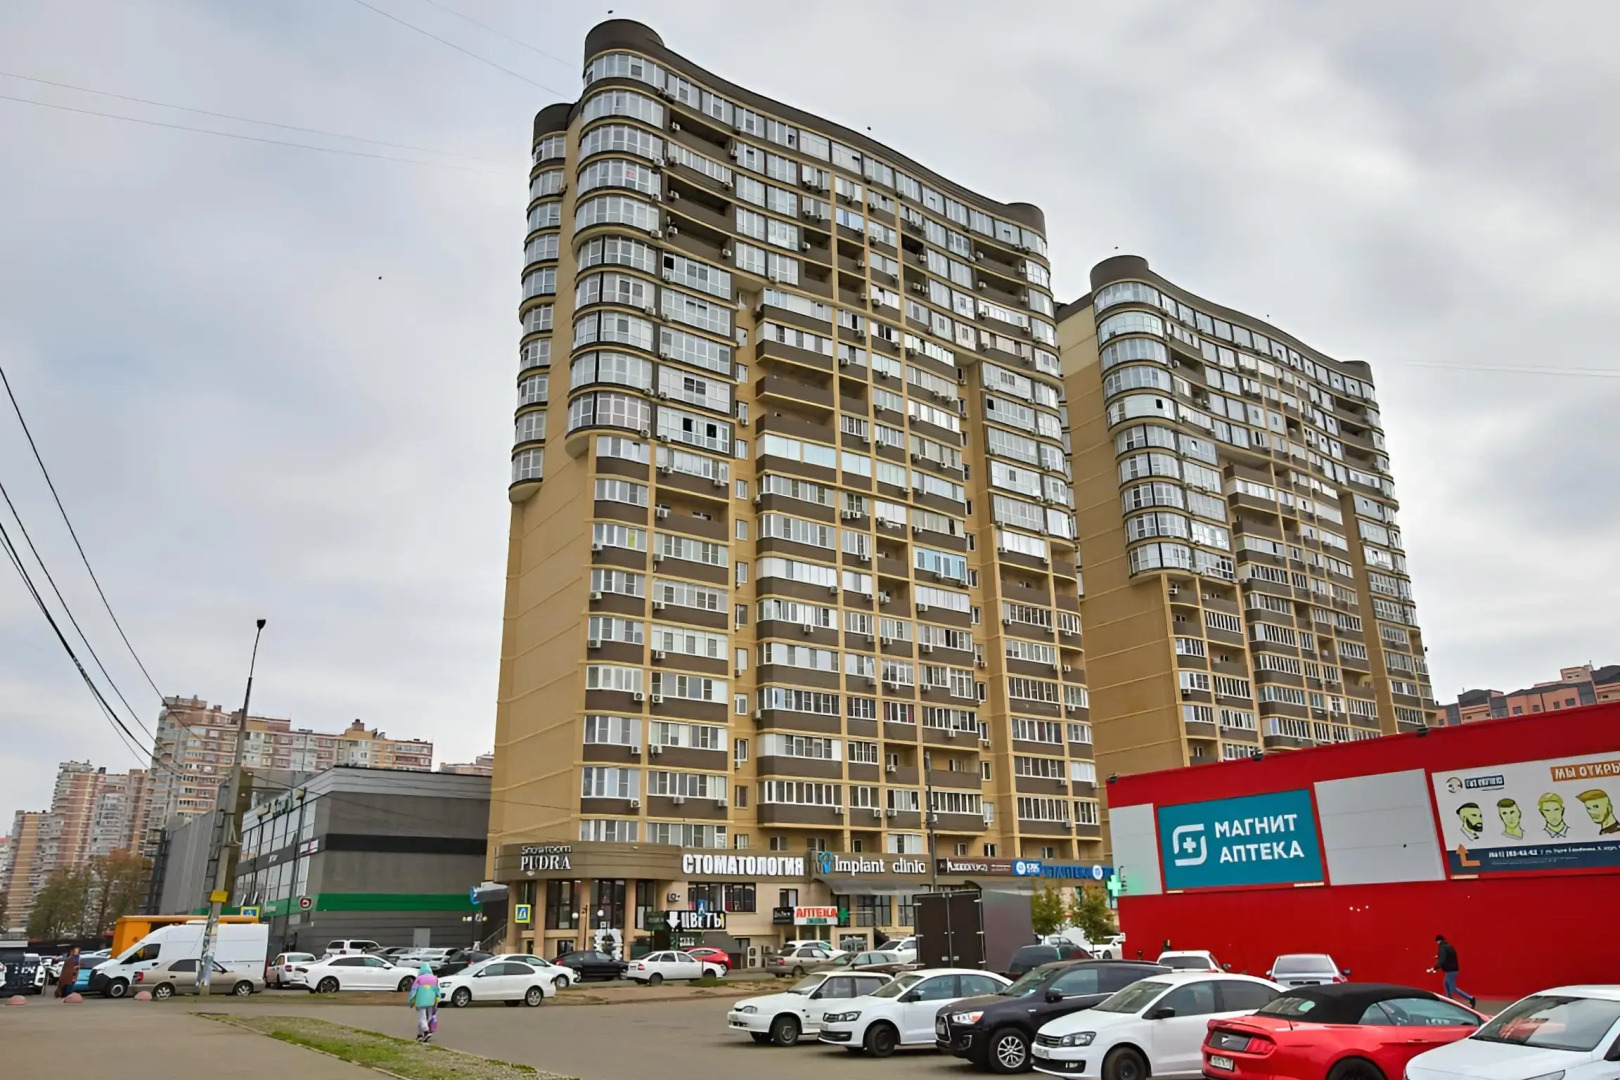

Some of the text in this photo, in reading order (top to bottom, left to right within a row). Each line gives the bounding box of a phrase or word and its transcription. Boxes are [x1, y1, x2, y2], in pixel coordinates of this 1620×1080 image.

[1215, 813, 1297, 838] МАГНИТ
[1220, 840, 1304, 863] АПТЕКА
[521, 855, 571, 871] PUDRA
[682, 853, 805, 876] СТОМАТОЛОГИЯ
[834, 855, 885, 876] Implant
[892, 857, 926, 873] clinic
[681, 911, 725, 929] ЦВЕТЫ
